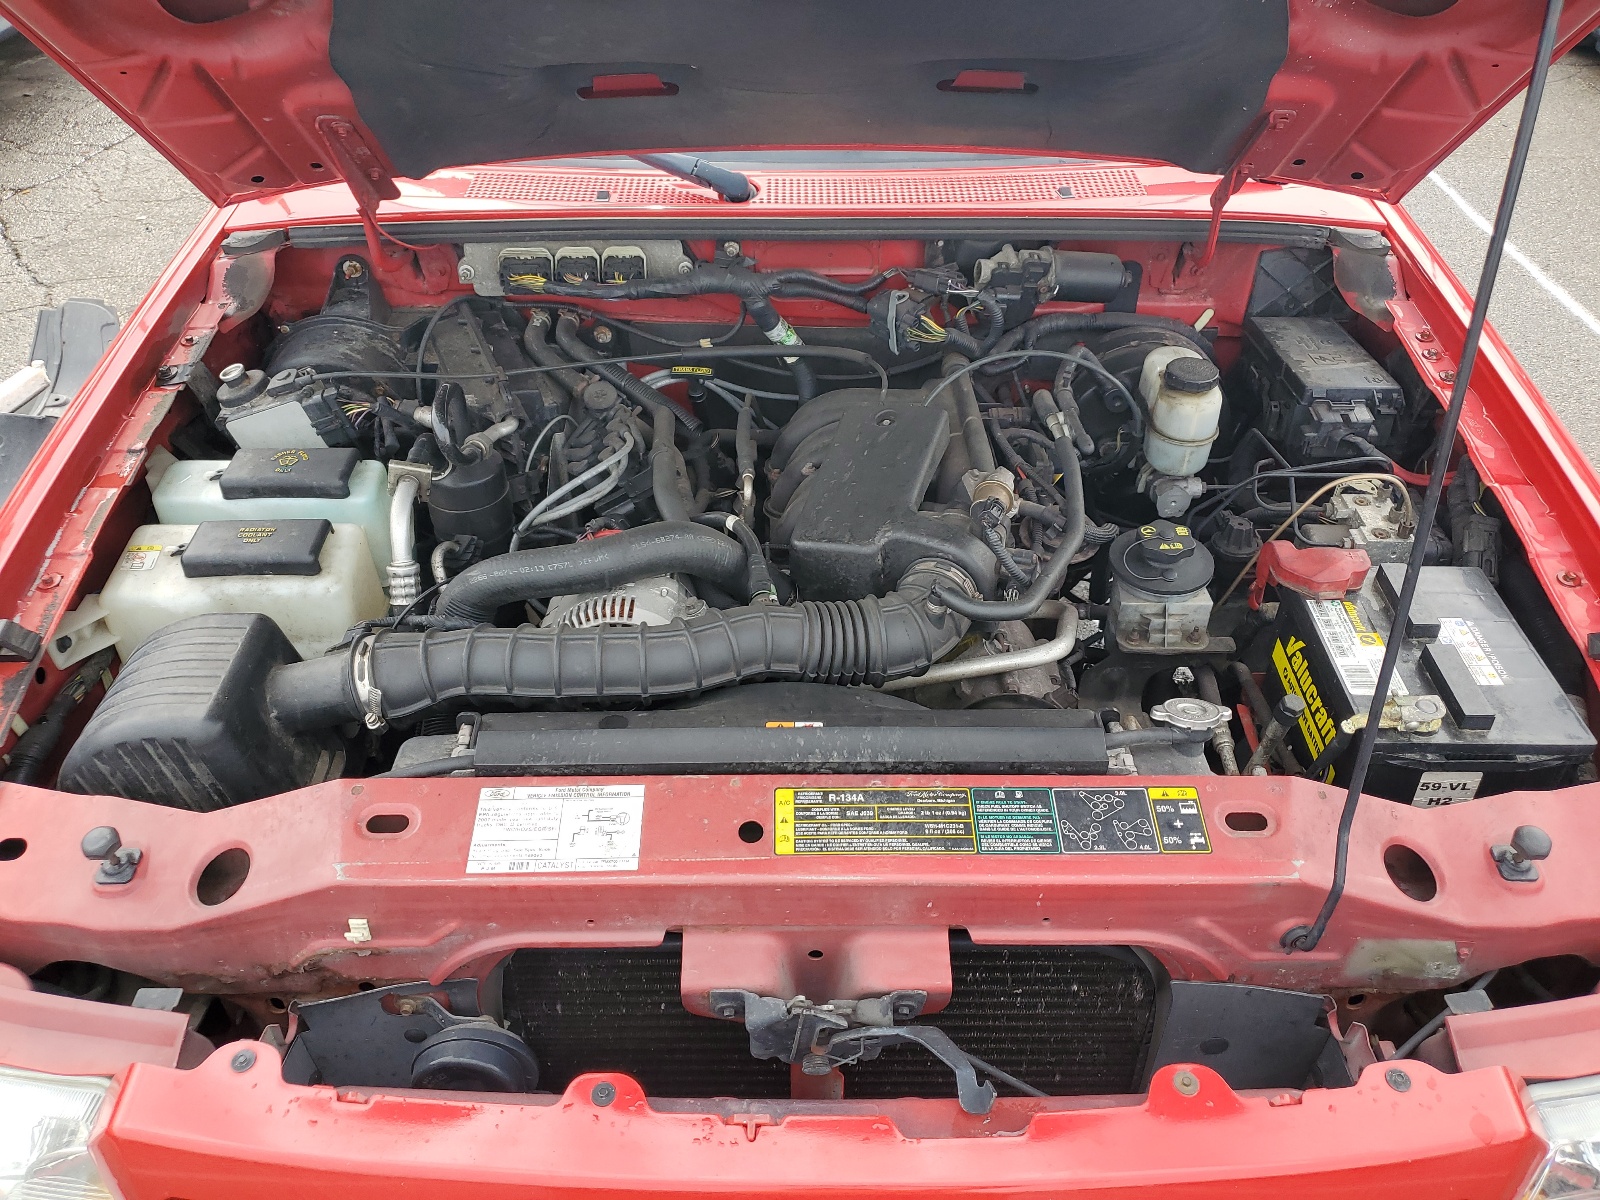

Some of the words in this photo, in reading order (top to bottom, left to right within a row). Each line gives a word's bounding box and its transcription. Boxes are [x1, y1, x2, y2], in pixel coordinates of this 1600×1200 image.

[1286, 635, 1336, 746] Valucraft
[1419, 782, 1471, 791] 59-VL
[828, 793, 865, 802] R-134A
[1427, 797, 1453, 806] H2
[1156, 805, 1175, 813] 50%
[1163, 836, 1182, 844] 50%
[537, 861, 574, 869] CATALYST
